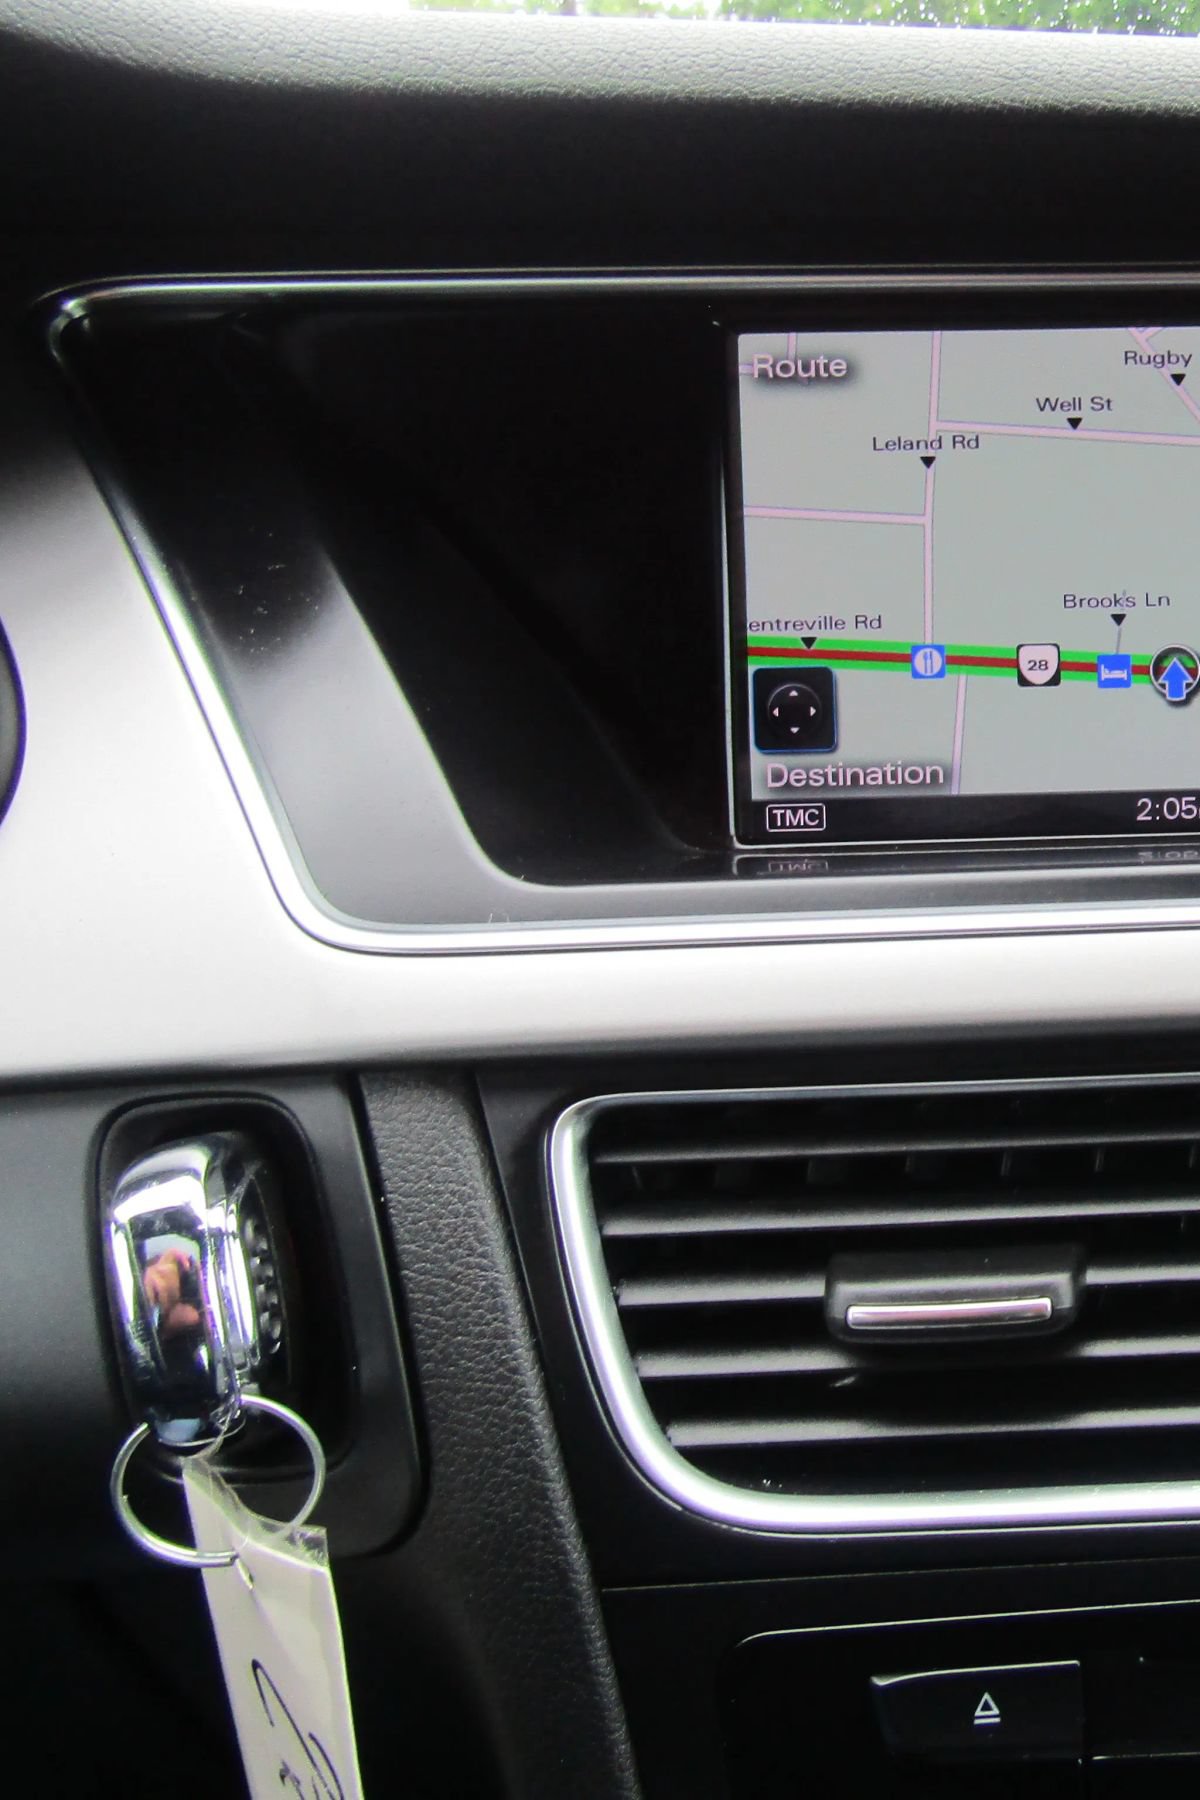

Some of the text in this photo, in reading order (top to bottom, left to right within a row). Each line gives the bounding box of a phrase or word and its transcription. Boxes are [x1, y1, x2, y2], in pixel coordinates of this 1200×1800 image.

[752, 354, 848, 379] Route
[1124, 350, 1192, 368] Rugby
[1036, 397, 1113, 413] Well St
[872, 435, 980, 452] Leland Rd
[1063, 593, 1170, 610] Brooks Ln
[747, 614, 882, 632] entreville Rd
[1027, 659, 1049, 672] 28
[765, 761, 945, 788] Destination
[772, 809, 820, 827] TMC
